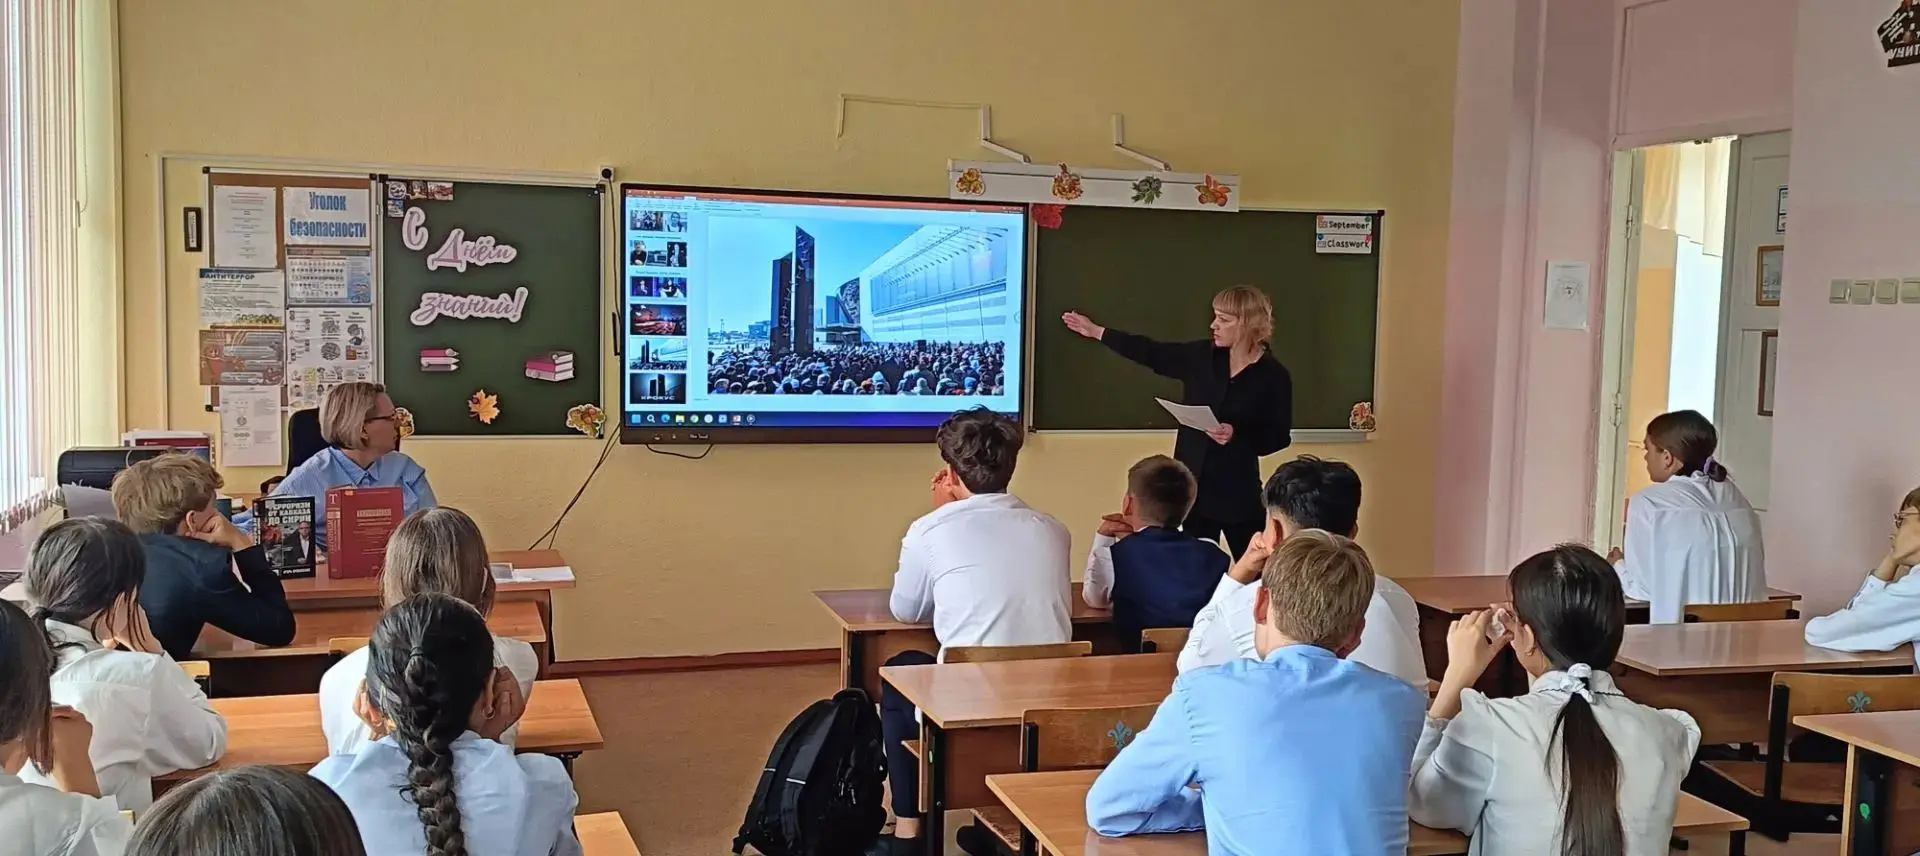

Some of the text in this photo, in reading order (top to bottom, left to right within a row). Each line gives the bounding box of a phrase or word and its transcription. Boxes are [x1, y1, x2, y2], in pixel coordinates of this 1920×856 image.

[309, 191, 347, 211] Уголок
[289, 218, 367, 238] безопасности
[403, 208, 428, 249] С
[1328, 221, 1369, 230] September
[429, 229, 515, 270] Днём
[1327, 240, 1369, 249] Classwork
[204, 272, 255, 280] АНТИТЕРРОР
[412, 288, 527, 323] знаний!
